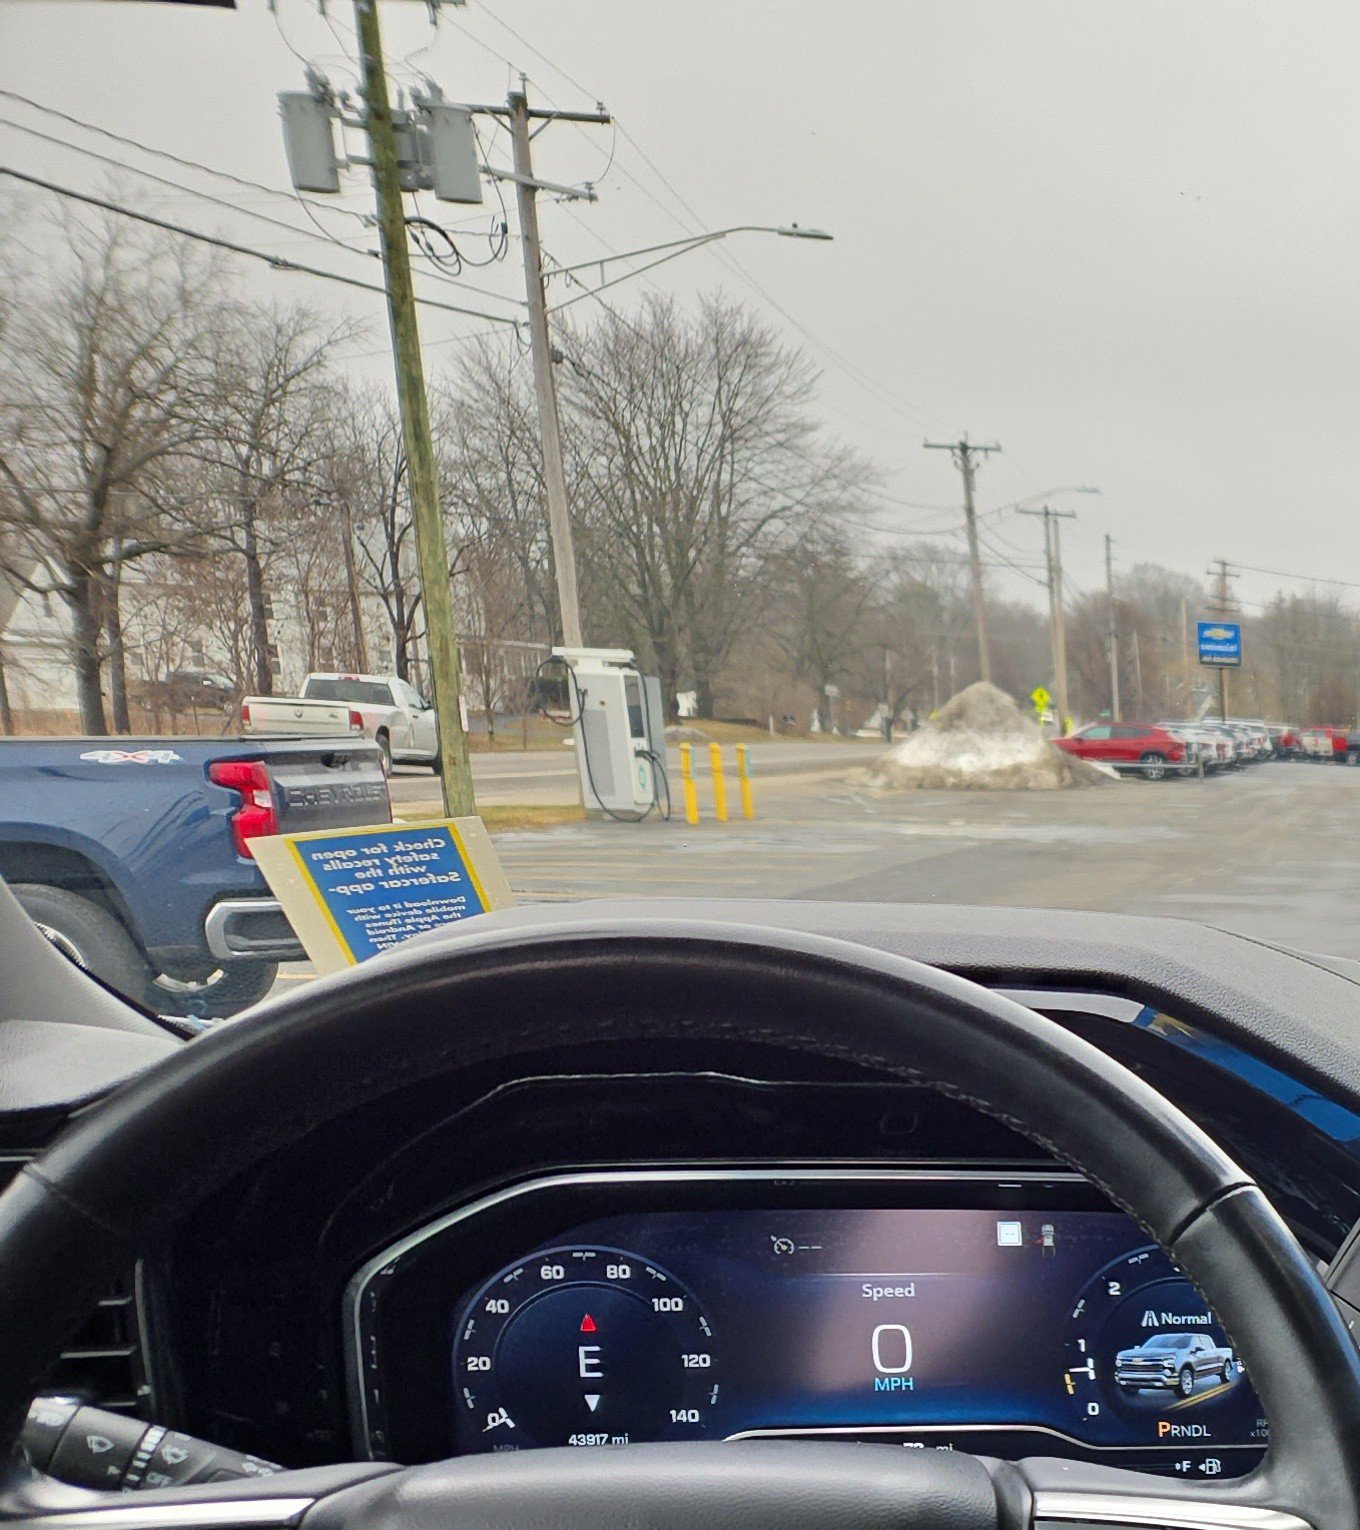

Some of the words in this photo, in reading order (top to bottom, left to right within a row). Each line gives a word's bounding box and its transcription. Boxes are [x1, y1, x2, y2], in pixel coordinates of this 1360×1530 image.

[540, 1265, 565, 1280] 60
[606, 1264, 631, 1280] 80
[862, 1283, 916, 1301] Speed
[1108, 1281, 1121, 1296] 2
[485, 1299, 510, 1314] 40
[652, 1298, 684, 1312] 100
[1161, 1312, 1212, 1326] Normal
[872, 1324, 912, 1374] 0
[1078, 1339, 1086, 1352] 1
[467, 1356, 492, 1372] 20
[578, 1346, 604, 1378] E
[682, 1354, 711, 1368] 120
[874, 1378, 914, 1392] MPH
[670, 1409, 700, 1422] 140
[1088, 1402, 1100, 1416] 0
[568, 1434, 608, 1446] 43917
[612, 1433, 628, 1446] mi
[1182, 1461, 1192, 1472] F
